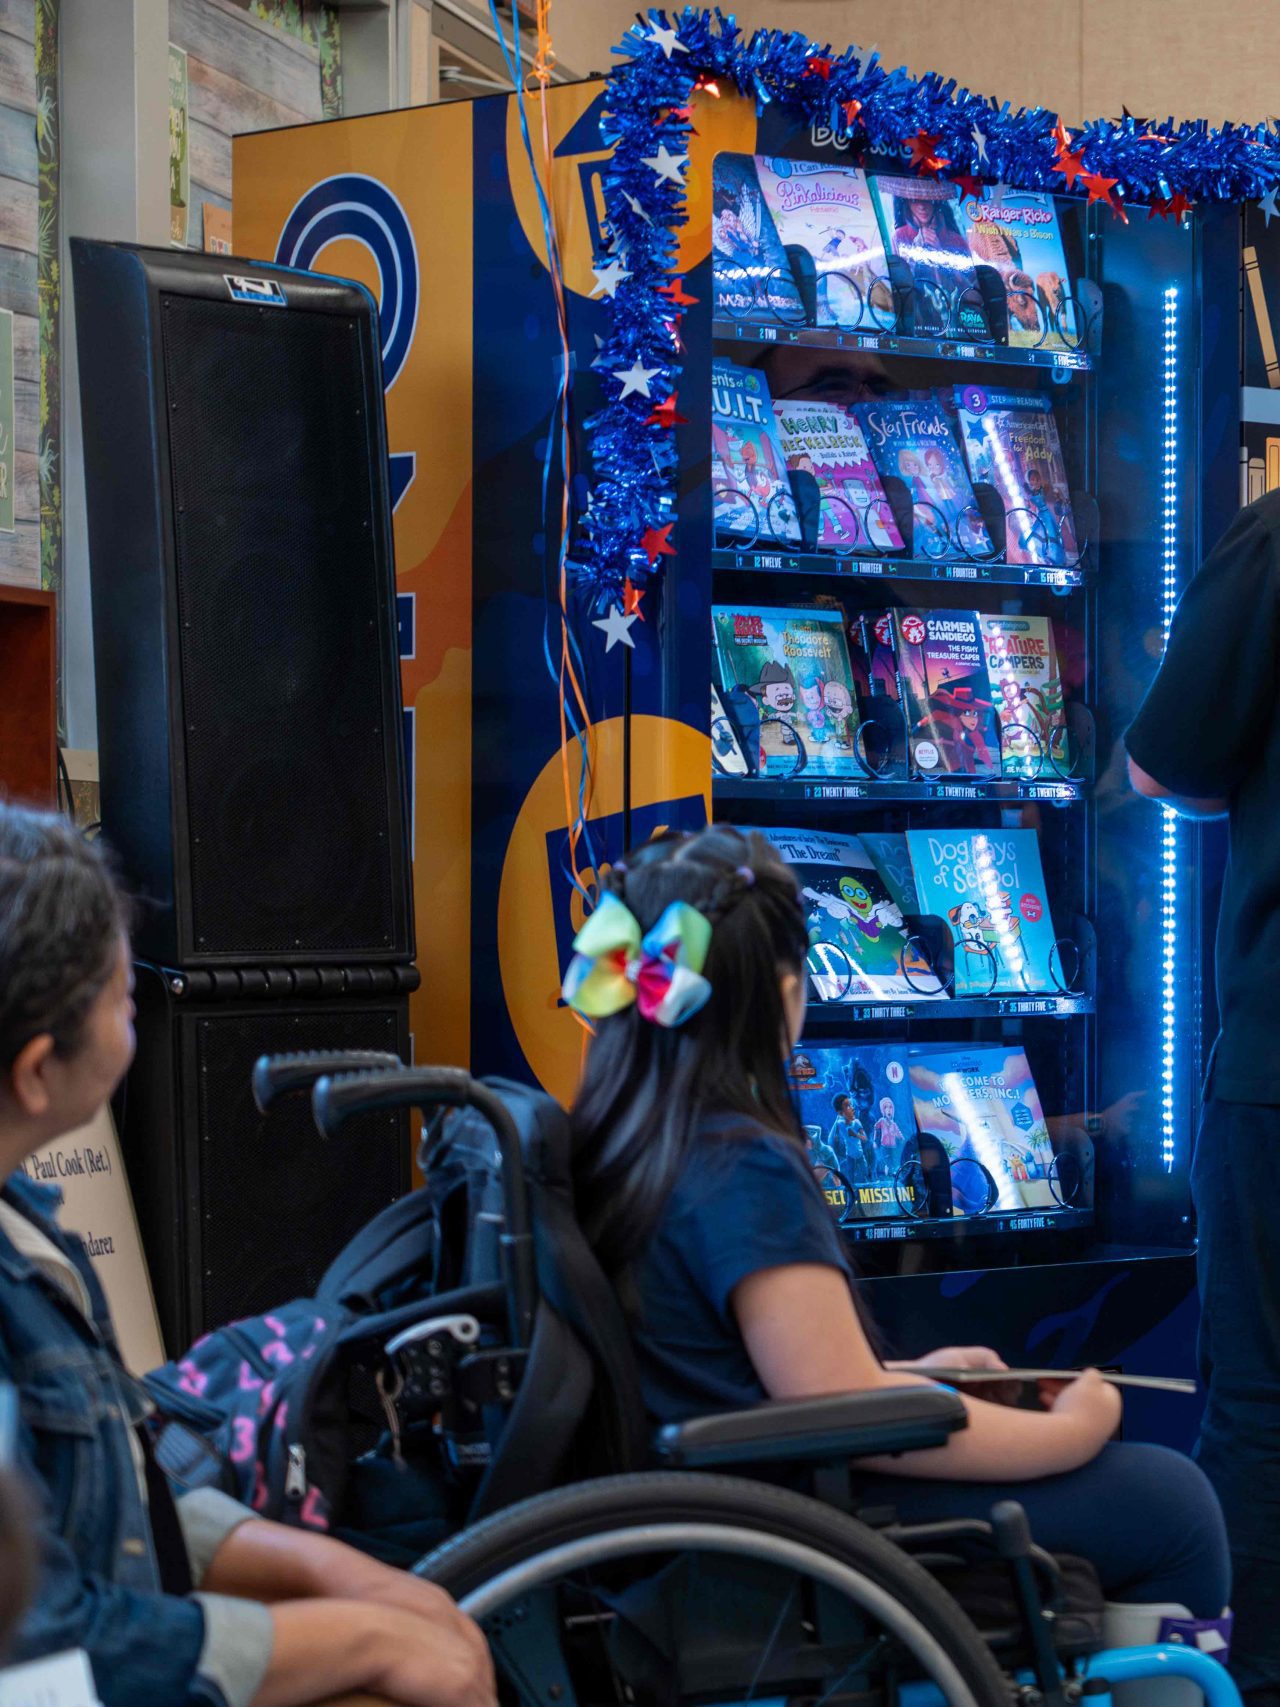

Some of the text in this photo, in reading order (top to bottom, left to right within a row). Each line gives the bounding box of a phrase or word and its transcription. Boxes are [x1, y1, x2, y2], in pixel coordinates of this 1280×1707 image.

[776, 181, 860, 207] Pinkalicious
[980, 204, 1048, 225] Ranger Rick
[759, 327, 777, 340] 2 TWO
[858, 336, 879, 348] 3 THREE
[961, 346, 975, 358] FOUR
[712, 388, 768, 424] .U.I.T.
[971, 393, 981, 407] 3
[868, 411, 949, 446] Star Friends
[1009, 432, 1046, 444] Freedom
[1025, 446, 1053, 463] Addy
[754, 556, 782, 569] 12 TWELVE
[852, 562, 883, 574] 13 THIRTEEN
[946, 567, 977, 578] 14 FOURTEEN
[1040, 572, 1046, 582] 15
[926, 620, 975, 633] CARMEN
[783, 631, 829, 645] Theodore
[928, 631, 976, 643] SANDIEGO
[783, 645, 832, 658] Roosevelt
[948, 644, 979, 653] THE FISHY
[983, 634, 1046, 658] RATURE
[926, 651, 980, 661] TREASURE CAPER
[814, 786, 859, 798] 23 TWENTY THREE
[937, 786, 976, 798] 25 TWENTY FIVE
[1036, 787, 1057, 798] TWENTY
[928, 837, 969, 865] Dog
[933, 864, 950, 888] of
[953, 863, 1020, 894] Scol
[1009, 1001, 1046, 1012] 35 THIRTY FIVE
[863, 1007, 905, 1019] 33 THIRTY THREE
[991, 1076, 1005, 1086] TO
[932, 1088, 1020, 1108] MOERS, INC.!
[32, 1152, 56, 1180] Paul
[56, 1149, 84, 1178] Cook
[84, 1145, 113, 1179] (Ret.)
[1010, 1218, 1045, 1230] 45 FORTY FIVE
[866, 1227, 906, 1239] 43 FORTY THREE
